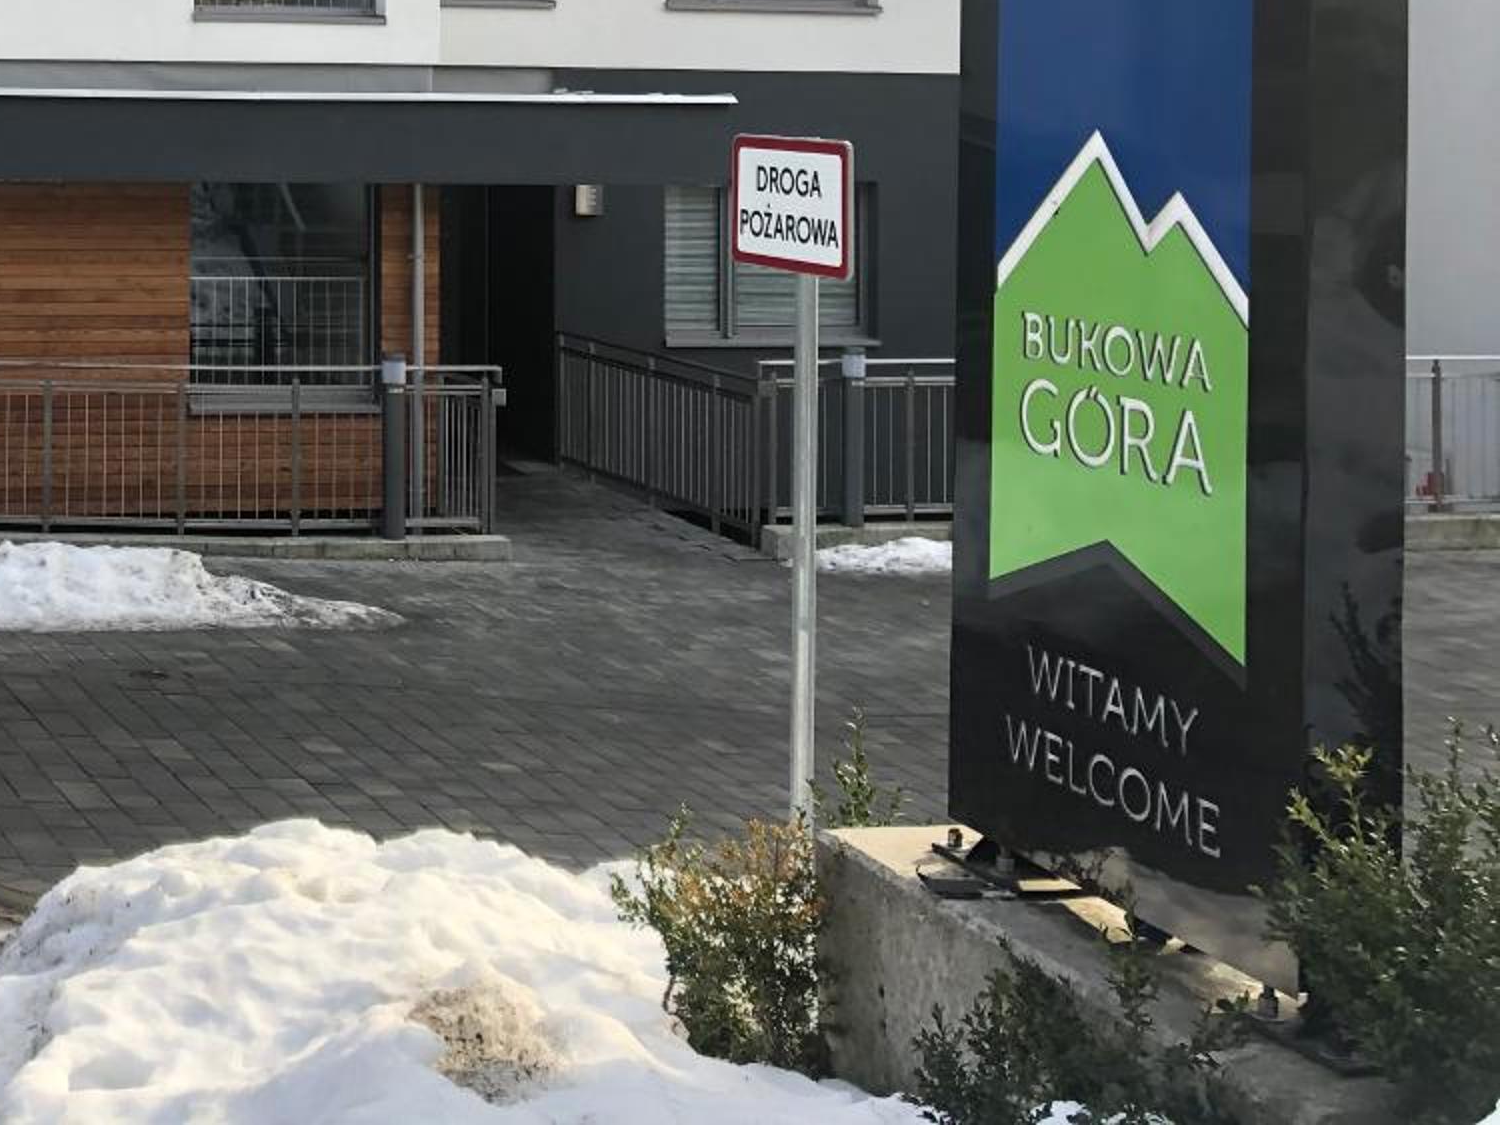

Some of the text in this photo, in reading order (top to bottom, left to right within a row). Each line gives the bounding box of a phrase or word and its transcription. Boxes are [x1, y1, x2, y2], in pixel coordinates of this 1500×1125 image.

[739, 203, 839, 248] POŻAROWA
[755, 165, 822, 199] DROGA
[1021, 310, 1212, 393] BUKOWA
[1019, 377, 1213, 496] GÓRA
[1028, 644, 1199, 757] WITAMY
[1005, 714, 1221, 859] WELCOME
